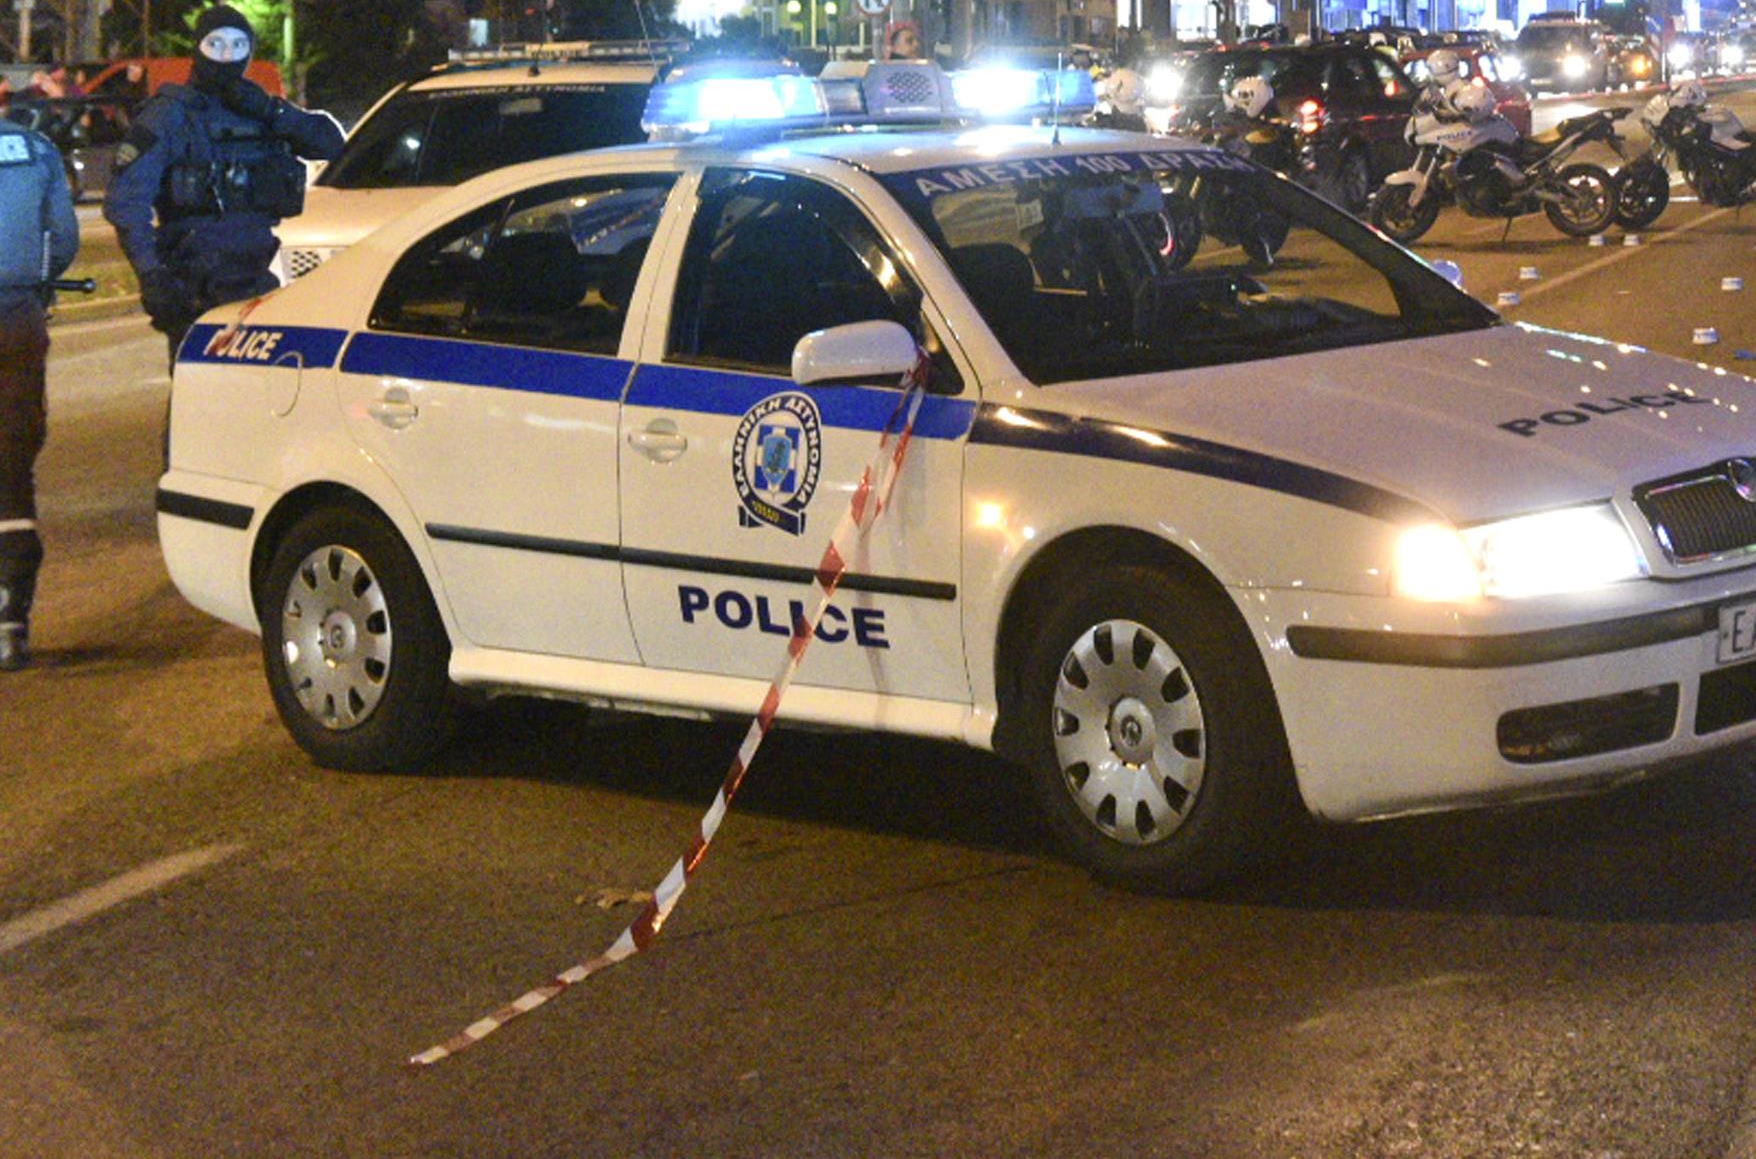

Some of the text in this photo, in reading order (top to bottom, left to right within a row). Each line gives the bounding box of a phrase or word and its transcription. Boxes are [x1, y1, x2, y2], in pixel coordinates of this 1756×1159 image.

[915, 159, 1071, 197] ΑΜΕΣΗ
[1075, 154, 1132, 175] 100
[1497, 392, 1712, 438] POLICE
[678, 584, 891, 650] POLICE
